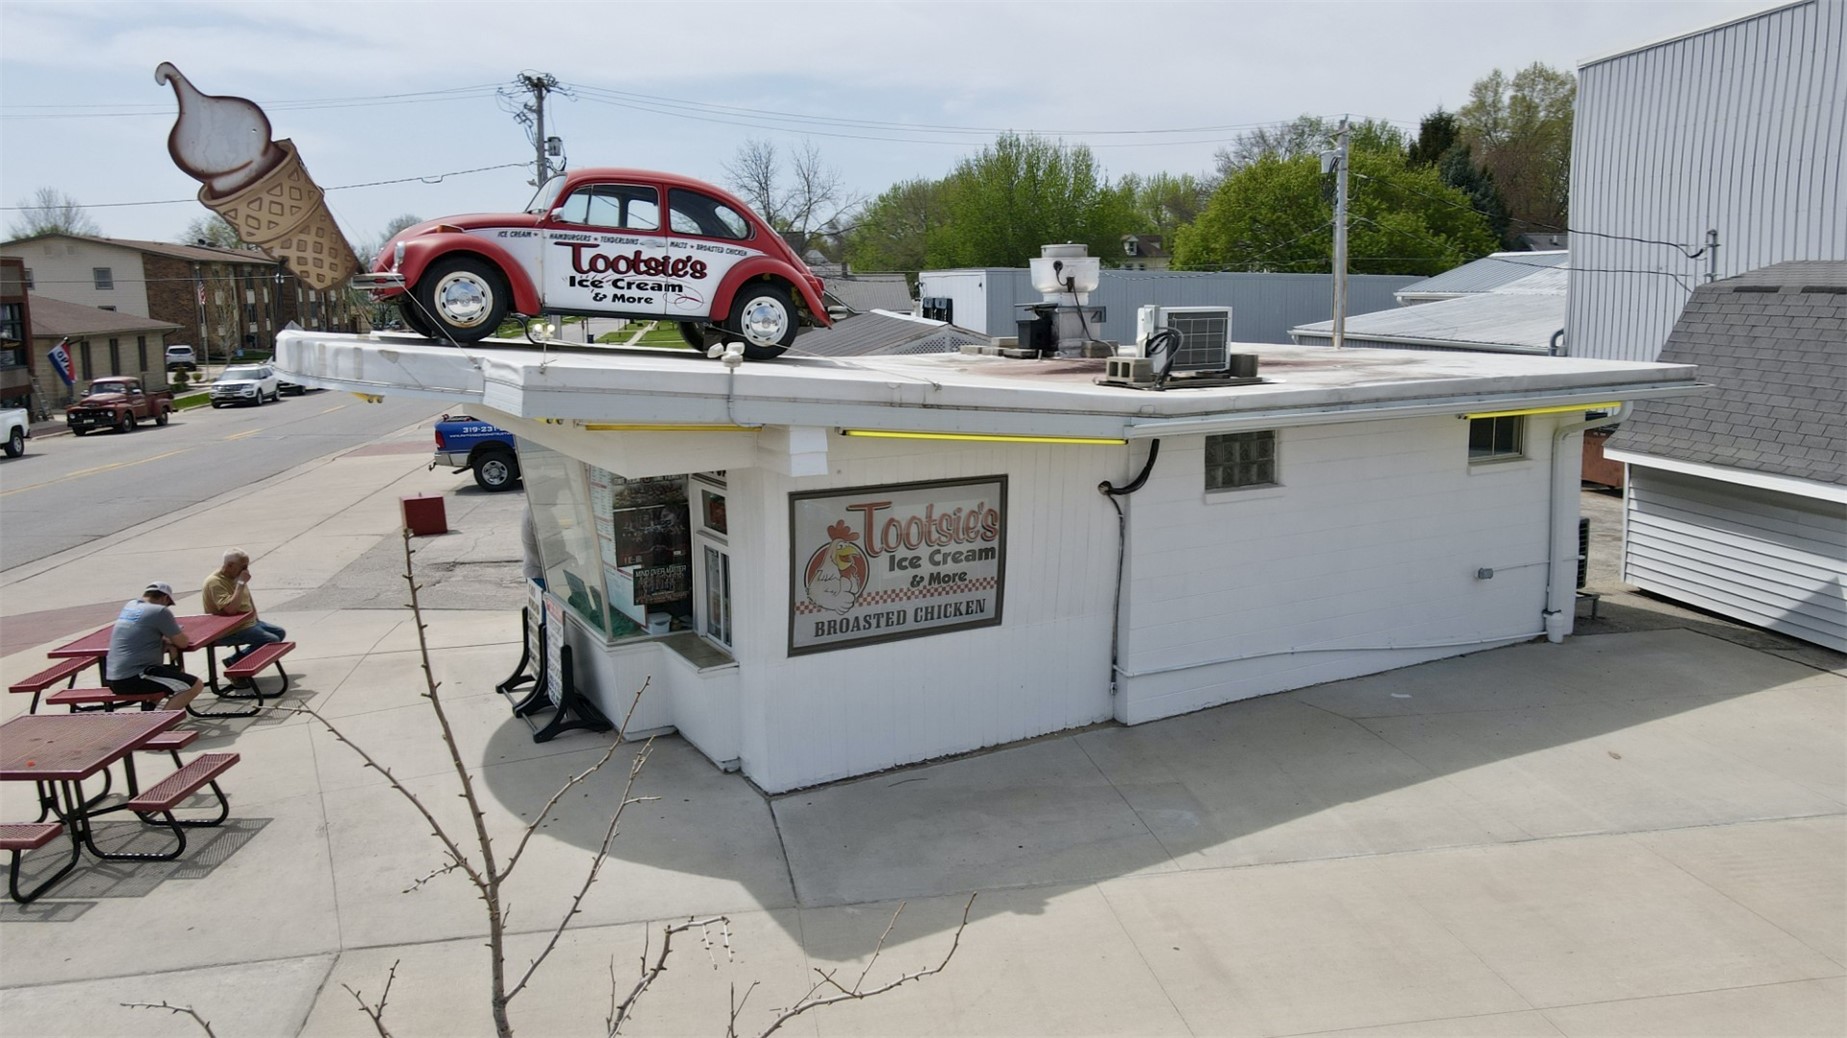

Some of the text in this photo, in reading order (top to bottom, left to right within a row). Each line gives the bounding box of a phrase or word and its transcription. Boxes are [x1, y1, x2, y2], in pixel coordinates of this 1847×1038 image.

[549, 233, 592, 242] HAMBURGERS
[696, 244, 725, 254] BROASTED
[725, 248, 748, 257] CHICKEN
[554, 241, 708, 280] Tootsie's
[569, 275, 684, 293] Ice Cream
[592, 292, 654, 305] & More
[846, 501, 1000, 558] Tootsie's
[888, 546, 997, 572] Ice Cream
[910, 571, 968, 588] & More
[814, 598, 986, 638] BROASTED CHICKEN
